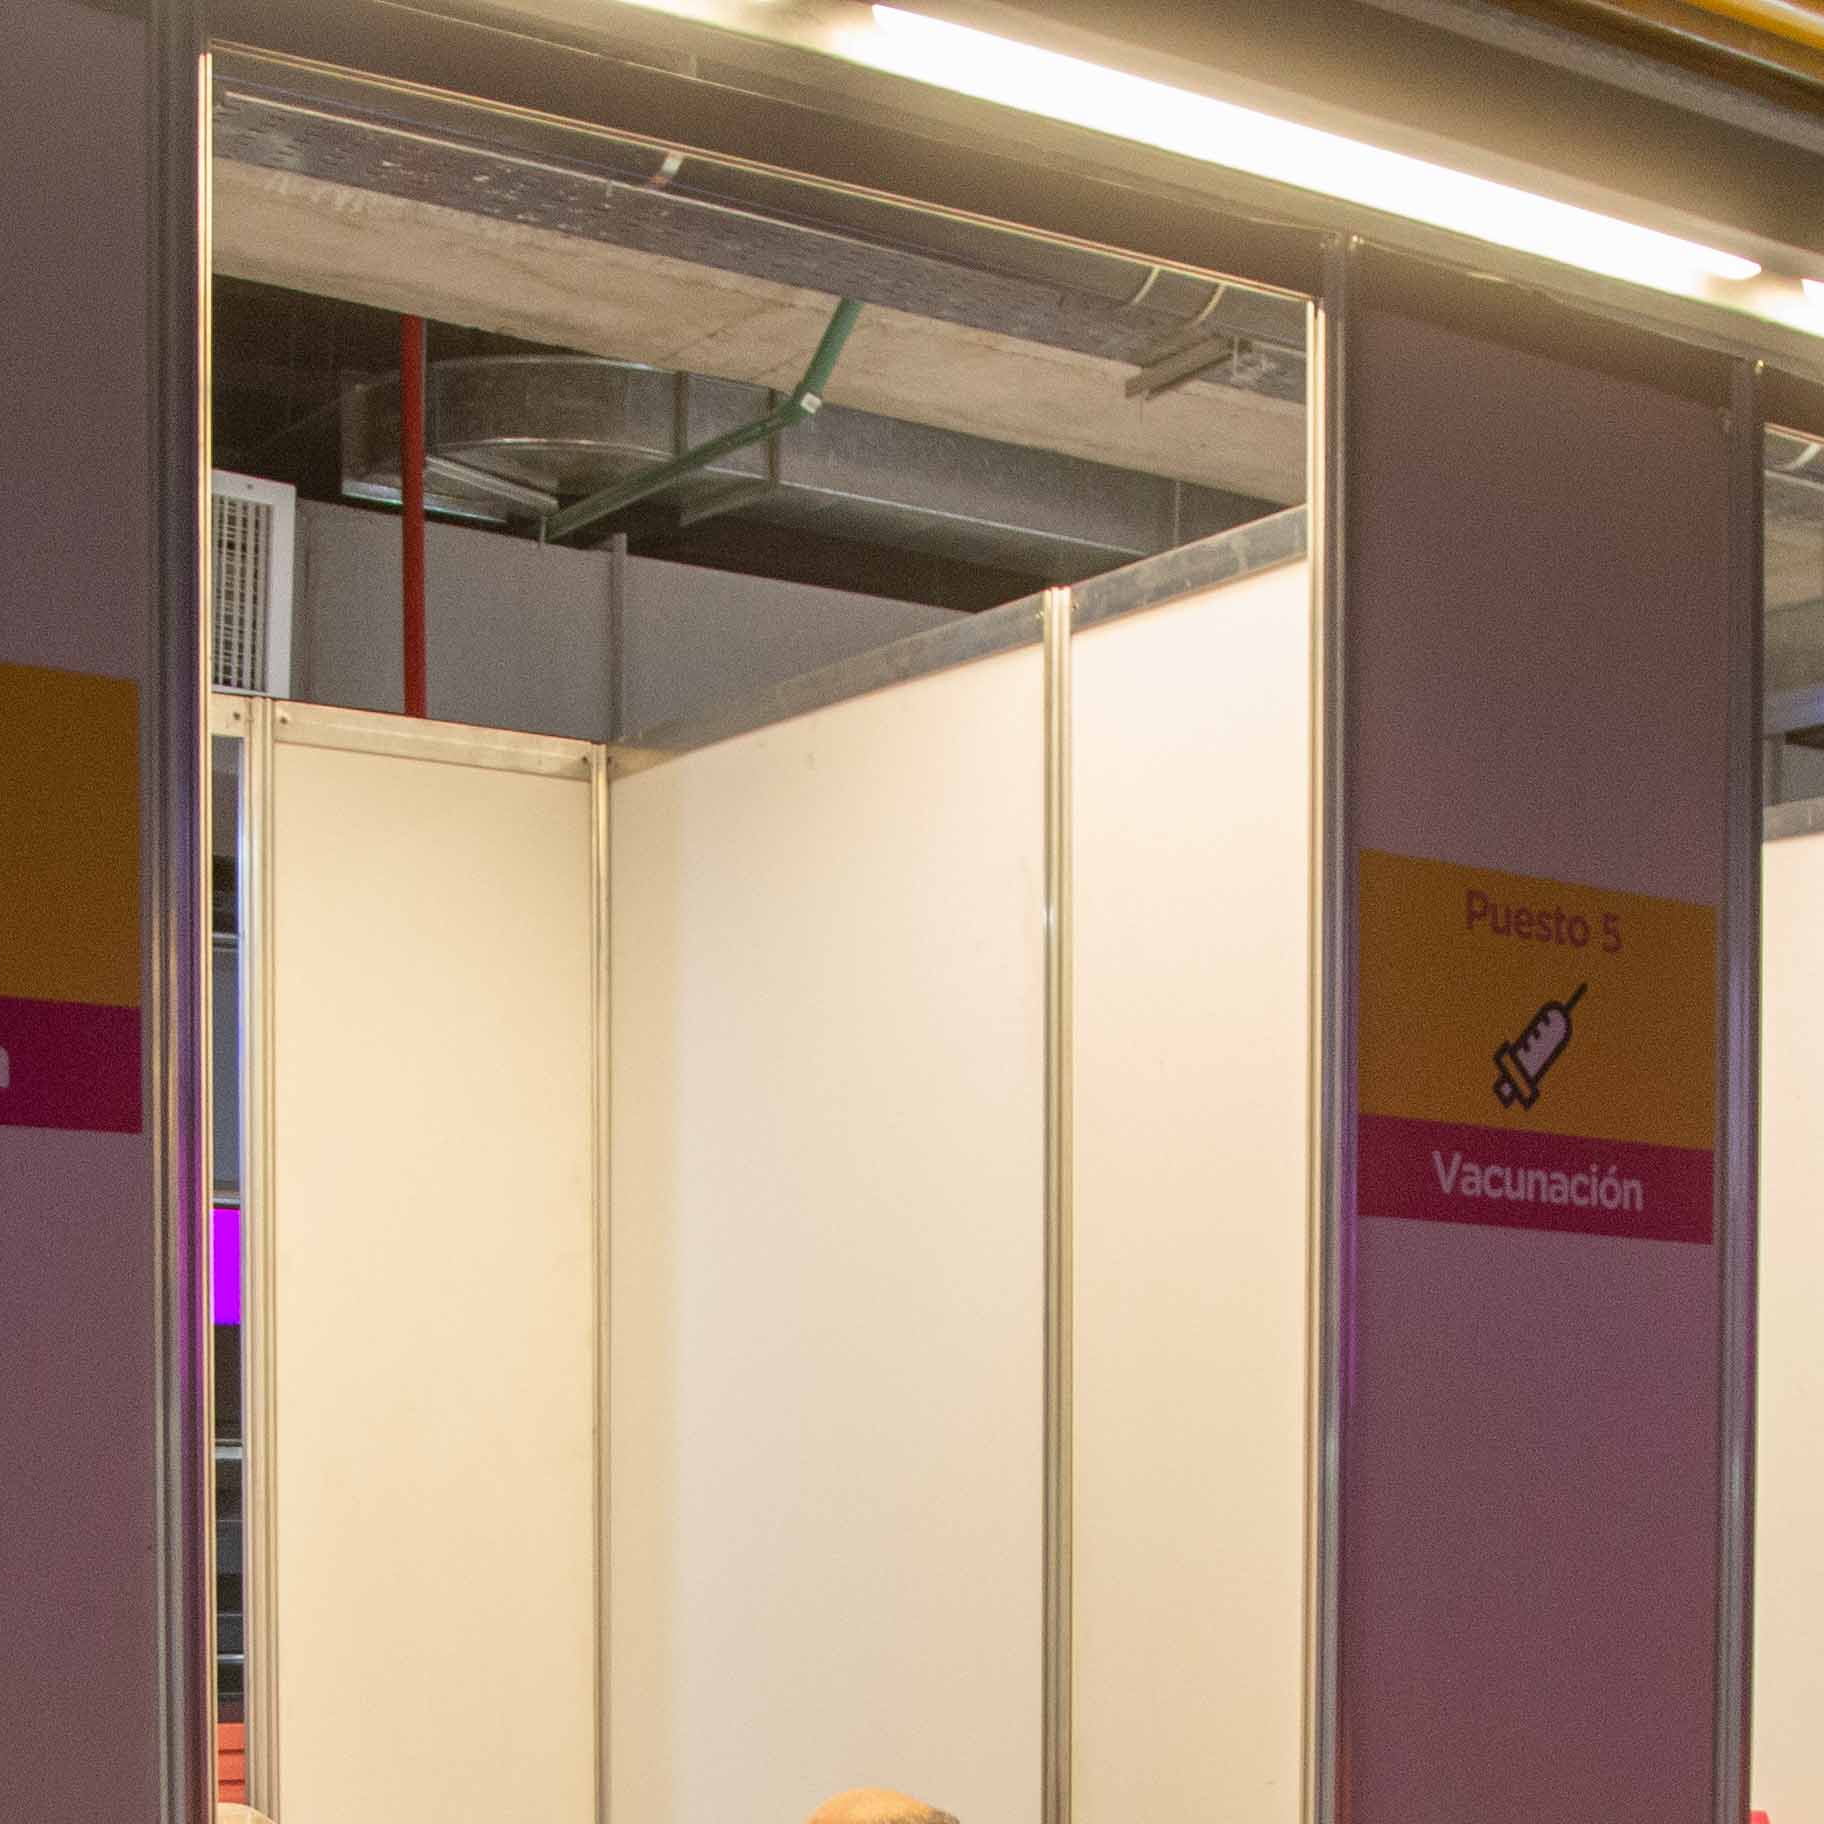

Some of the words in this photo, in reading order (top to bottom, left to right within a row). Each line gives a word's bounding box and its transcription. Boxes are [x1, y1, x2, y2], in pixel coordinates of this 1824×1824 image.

[1465, 890, 1591, 948] Puesto
[1602, 912, 1623, 954] 5
[1432, 1151, 1643, 1212] Vacunación
